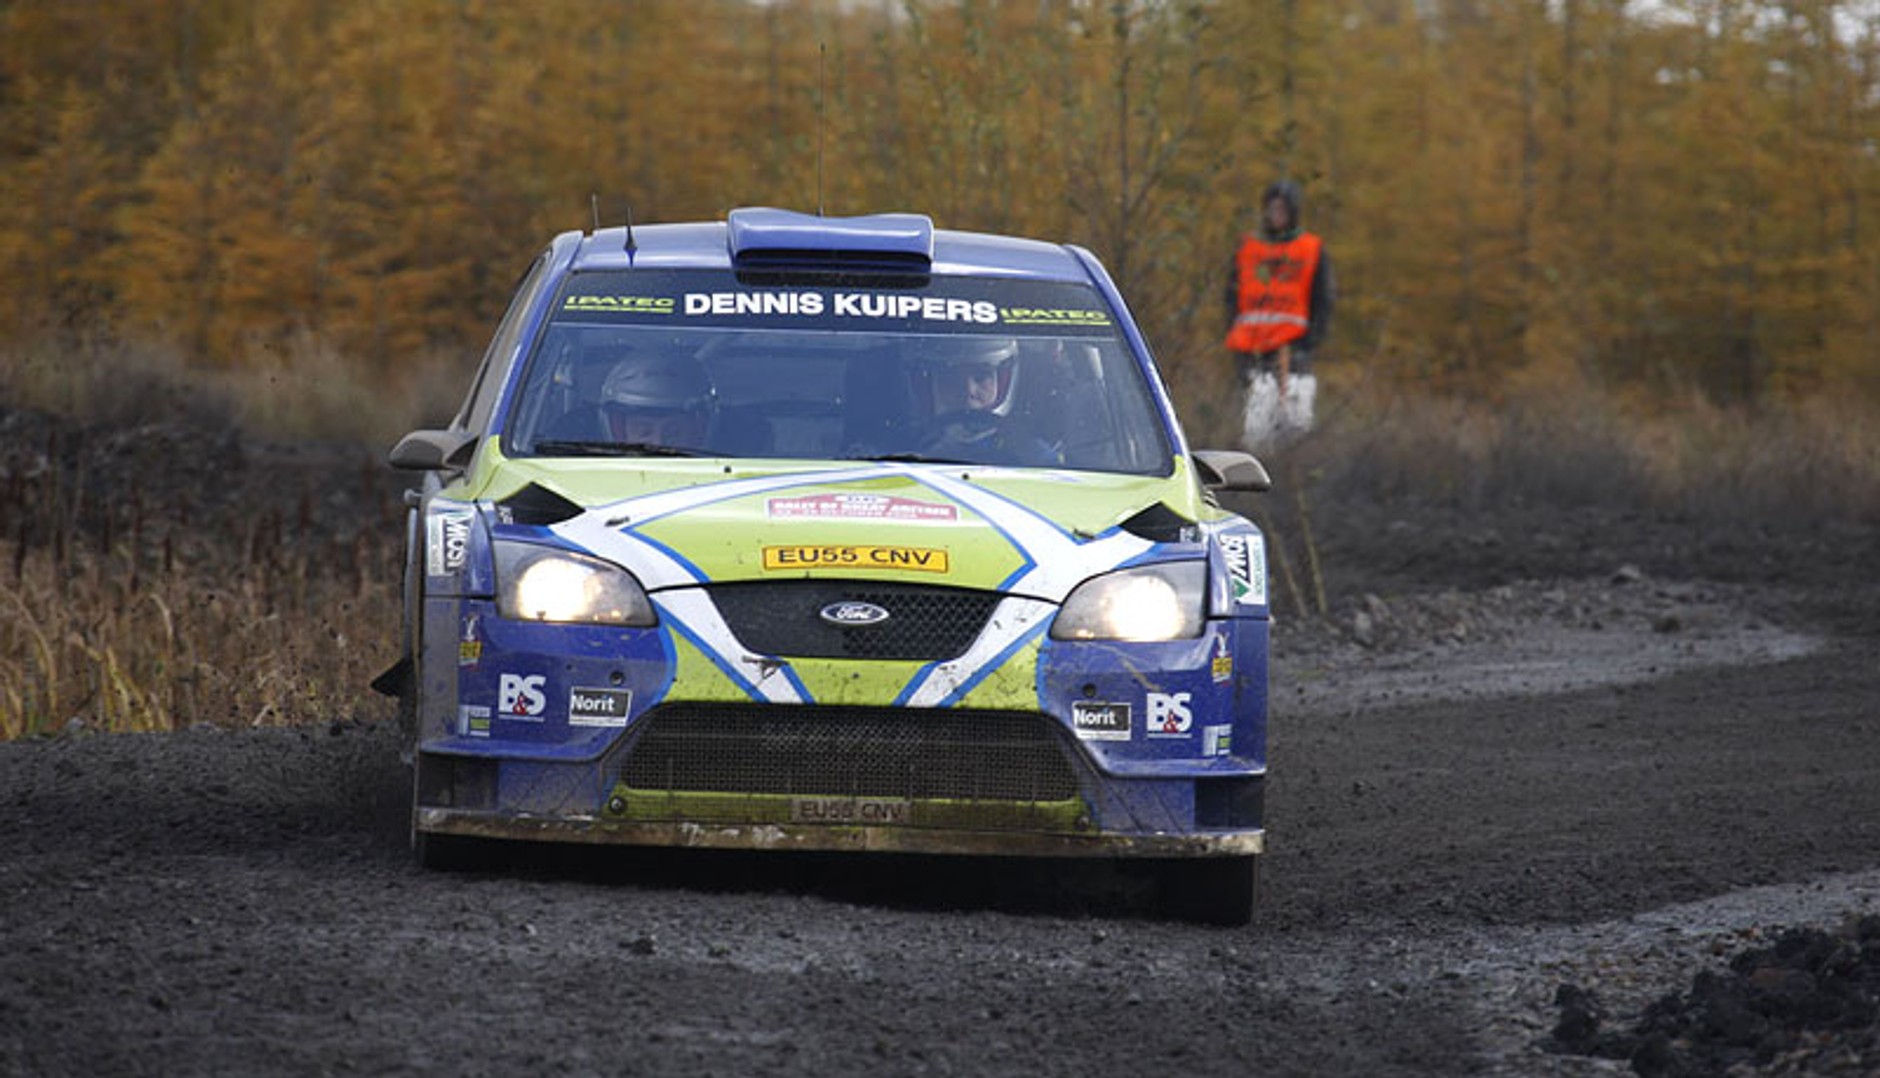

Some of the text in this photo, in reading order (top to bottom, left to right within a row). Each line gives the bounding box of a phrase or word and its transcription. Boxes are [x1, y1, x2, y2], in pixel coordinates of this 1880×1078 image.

[685, 293, 998, 323] DENNIS KUIPERS
[778, 548, 932, 566] EU55 CNV
[498, 673, 546, 716] B&S
[571, 693, 615, 712] Norit
[1074, 707, 1117, 725] Norit
[1146, 692, 1193, 734] B&S
[861, 803, 903, 819] CNV
